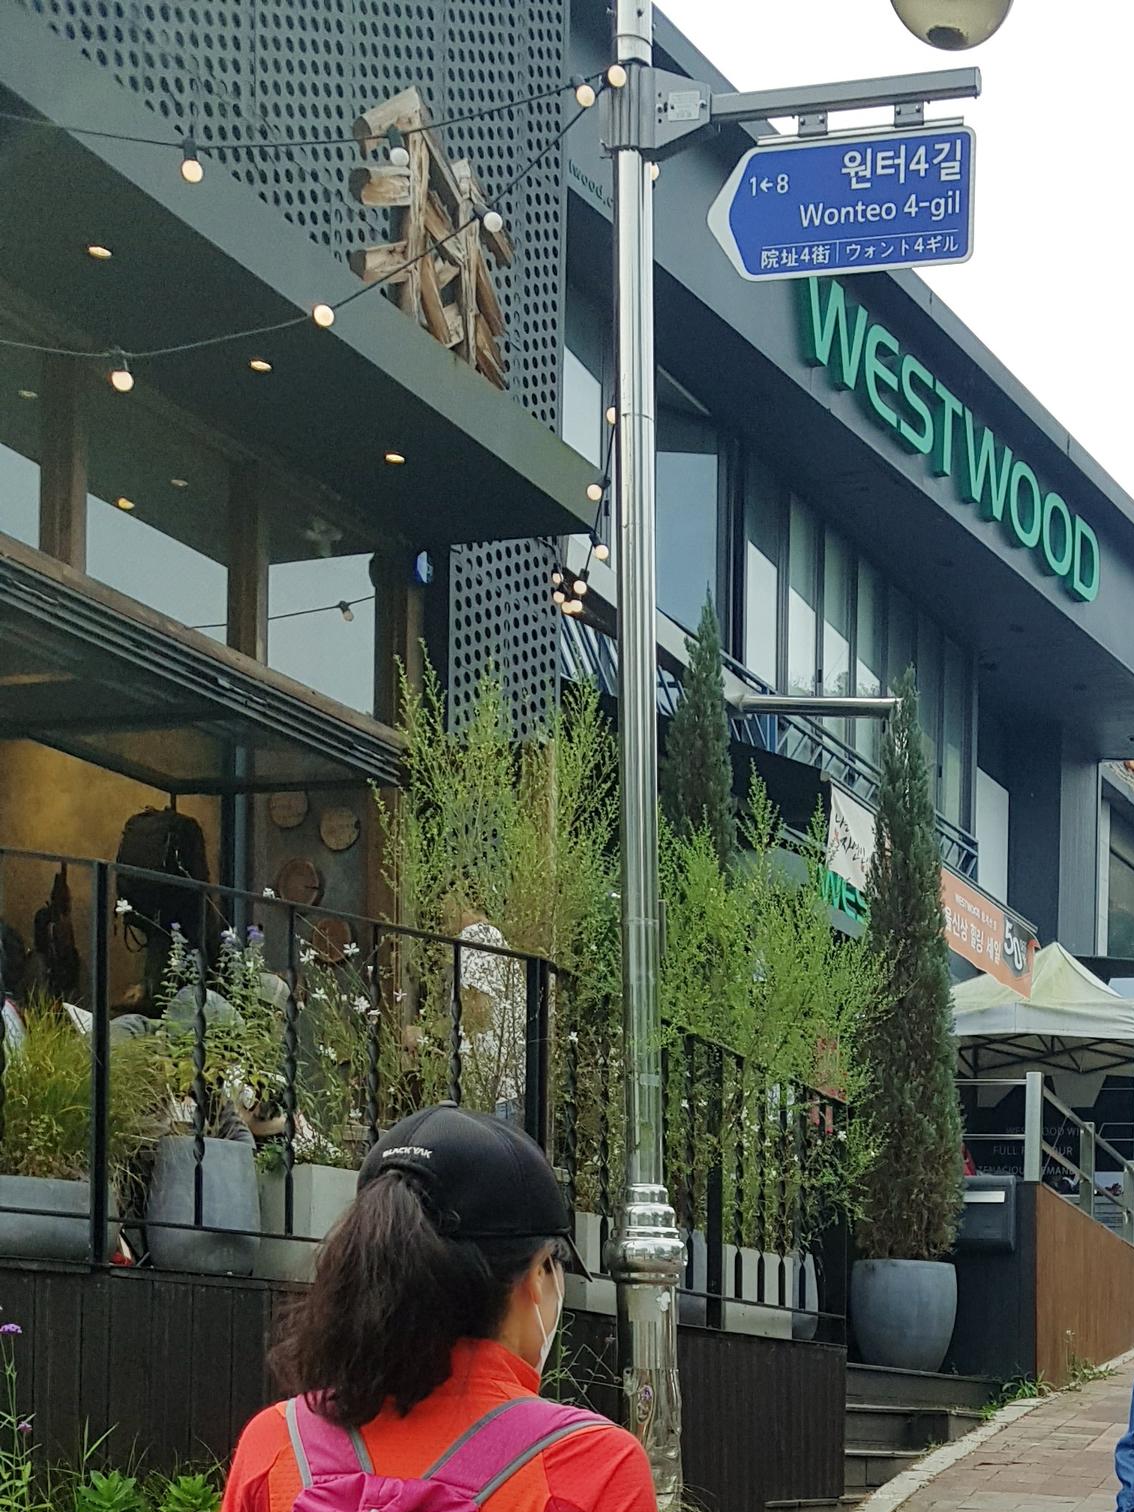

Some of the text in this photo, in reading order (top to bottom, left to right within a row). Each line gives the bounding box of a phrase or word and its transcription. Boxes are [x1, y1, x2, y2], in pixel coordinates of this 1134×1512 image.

[841, 138, 962, 190] 원터4길
[799, 190, 961, 228] Wonteo 4-gil
[845, 235, 959, 262] ウォント4ギル
[806, 276, 1101, 602] WESTWOOD
[1003, 919, 1024, 970] 50
